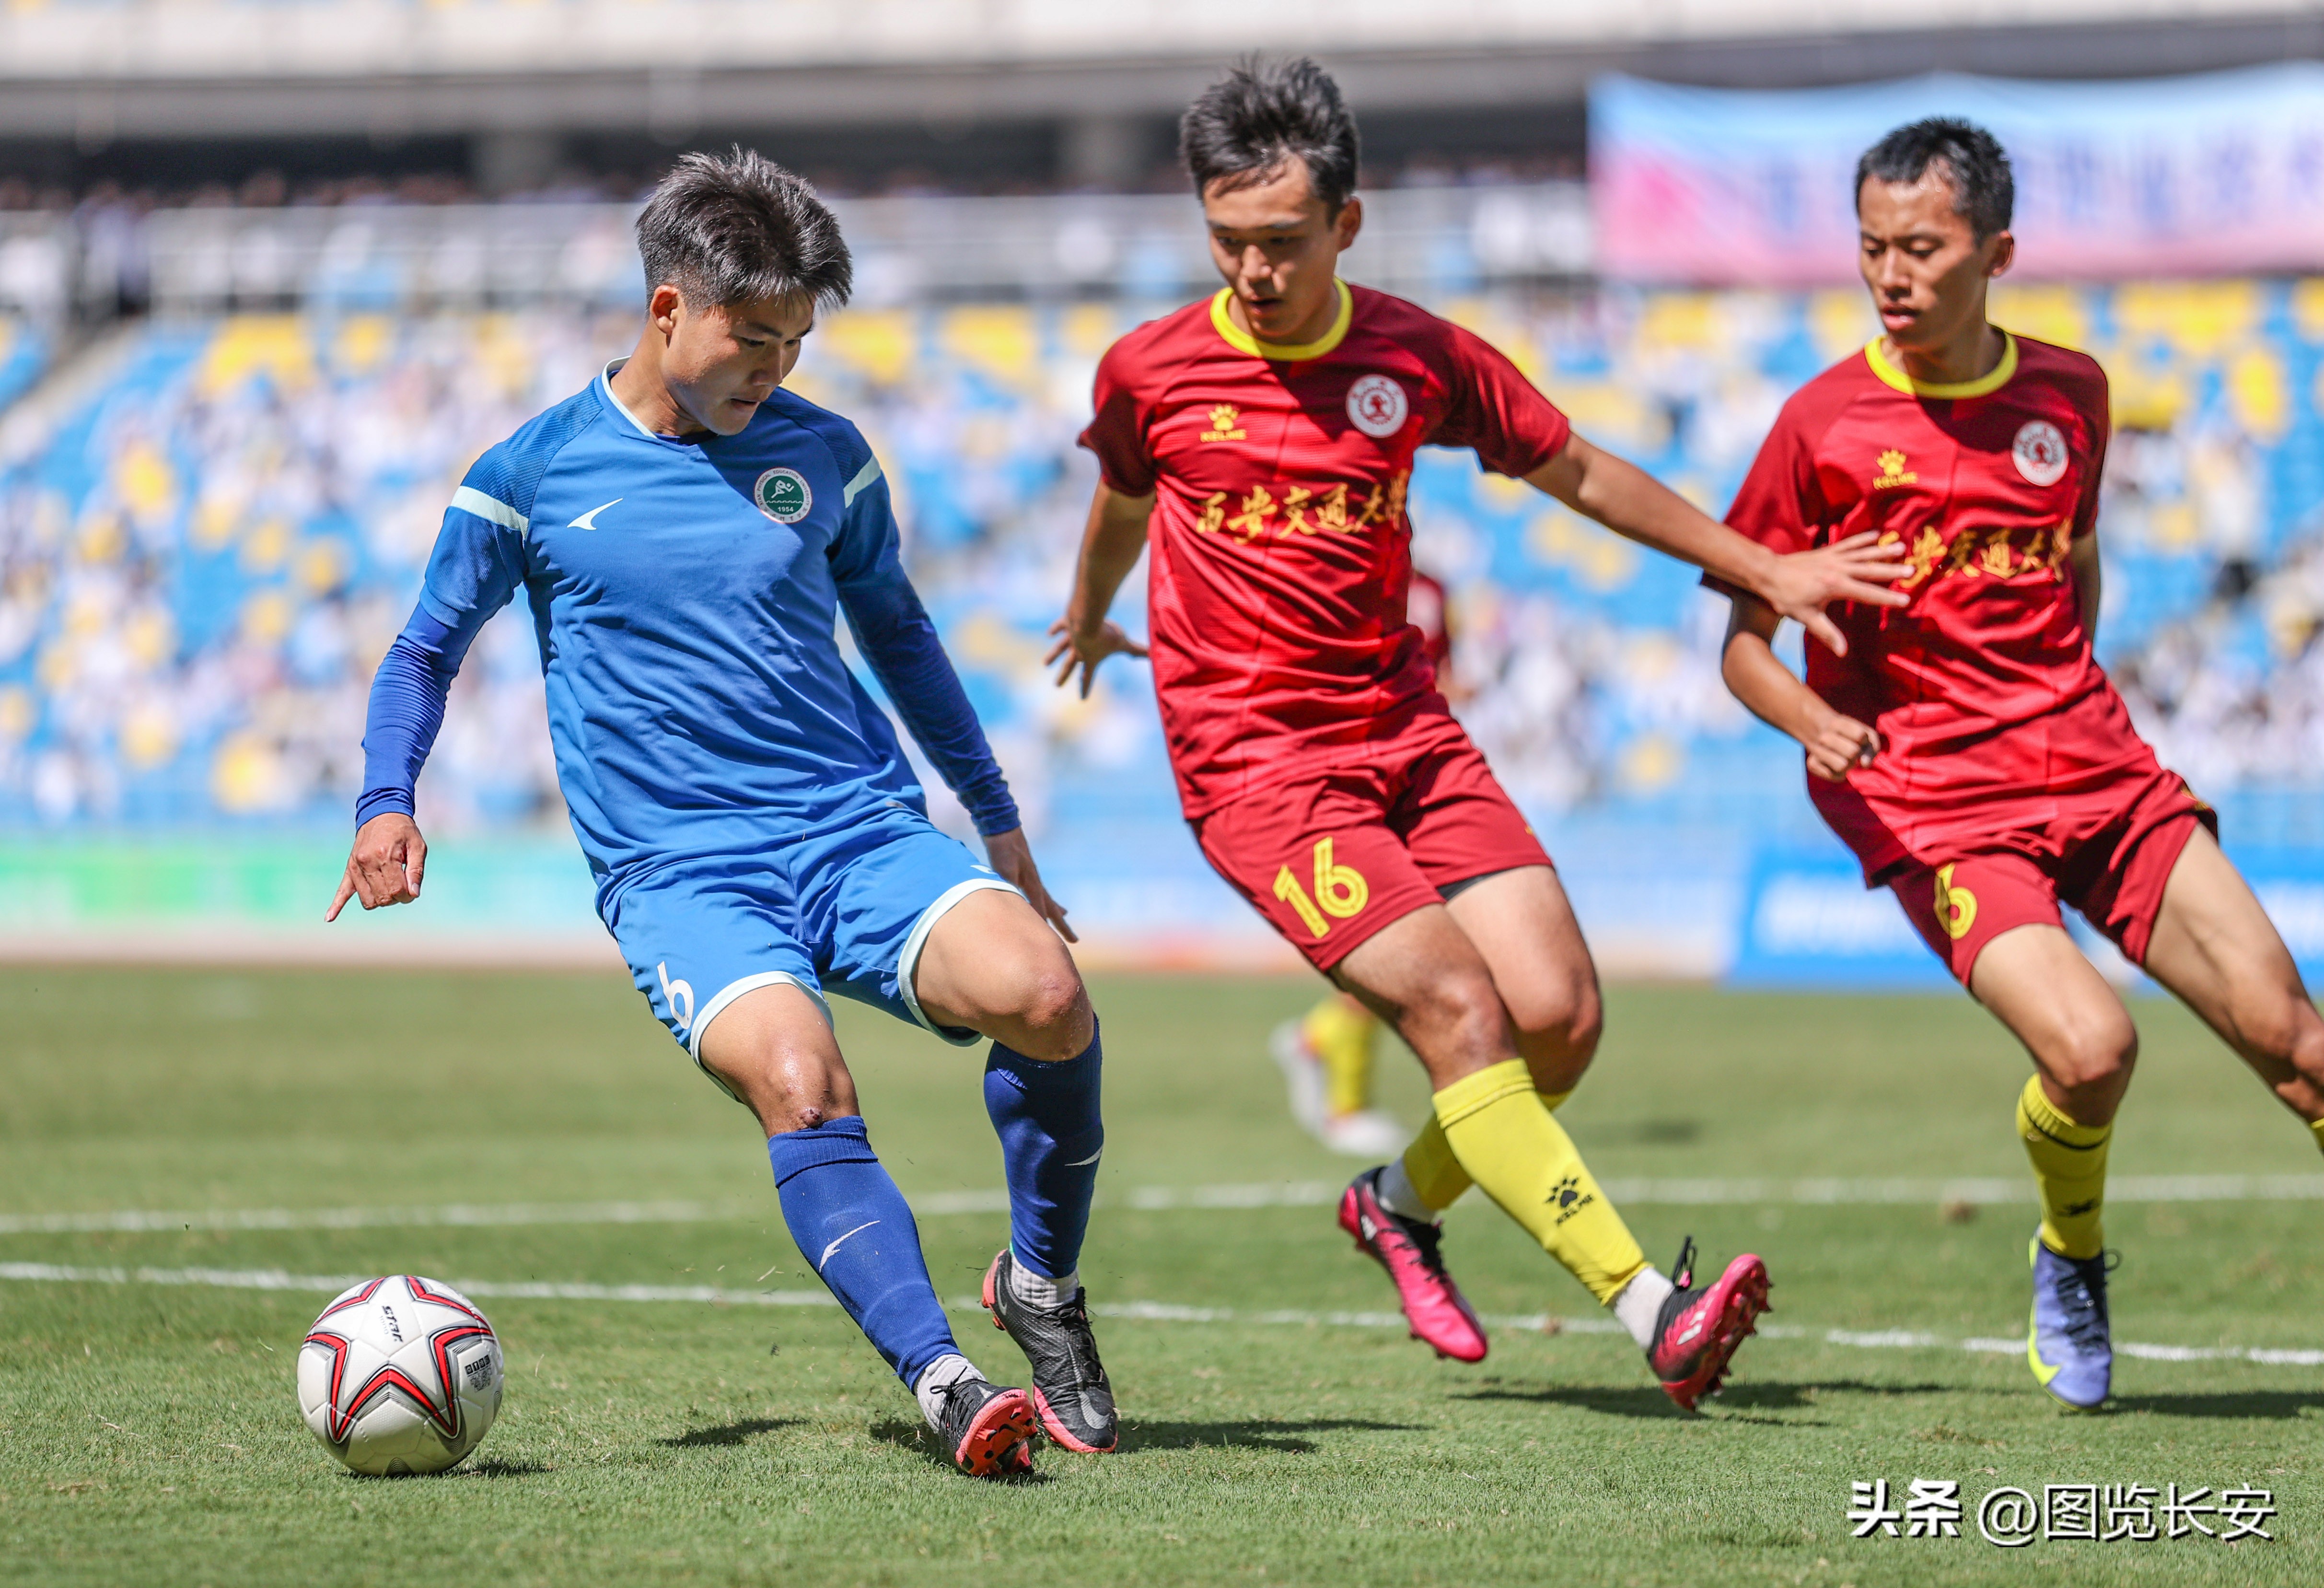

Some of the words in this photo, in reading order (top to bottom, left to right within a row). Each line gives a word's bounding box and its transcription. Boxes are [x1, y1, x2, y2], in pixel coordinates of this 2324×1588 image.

[758, 473, 771, 491] PHYSICAL
[773, 469, 799, 479] EDUCATION
[800, 480, 809, 506] UNIVERSITY
[1272, 835, 1370, 939] 16
[1933, 862, 1977, 940] 6
[657, 960, 694, 1029] 6
